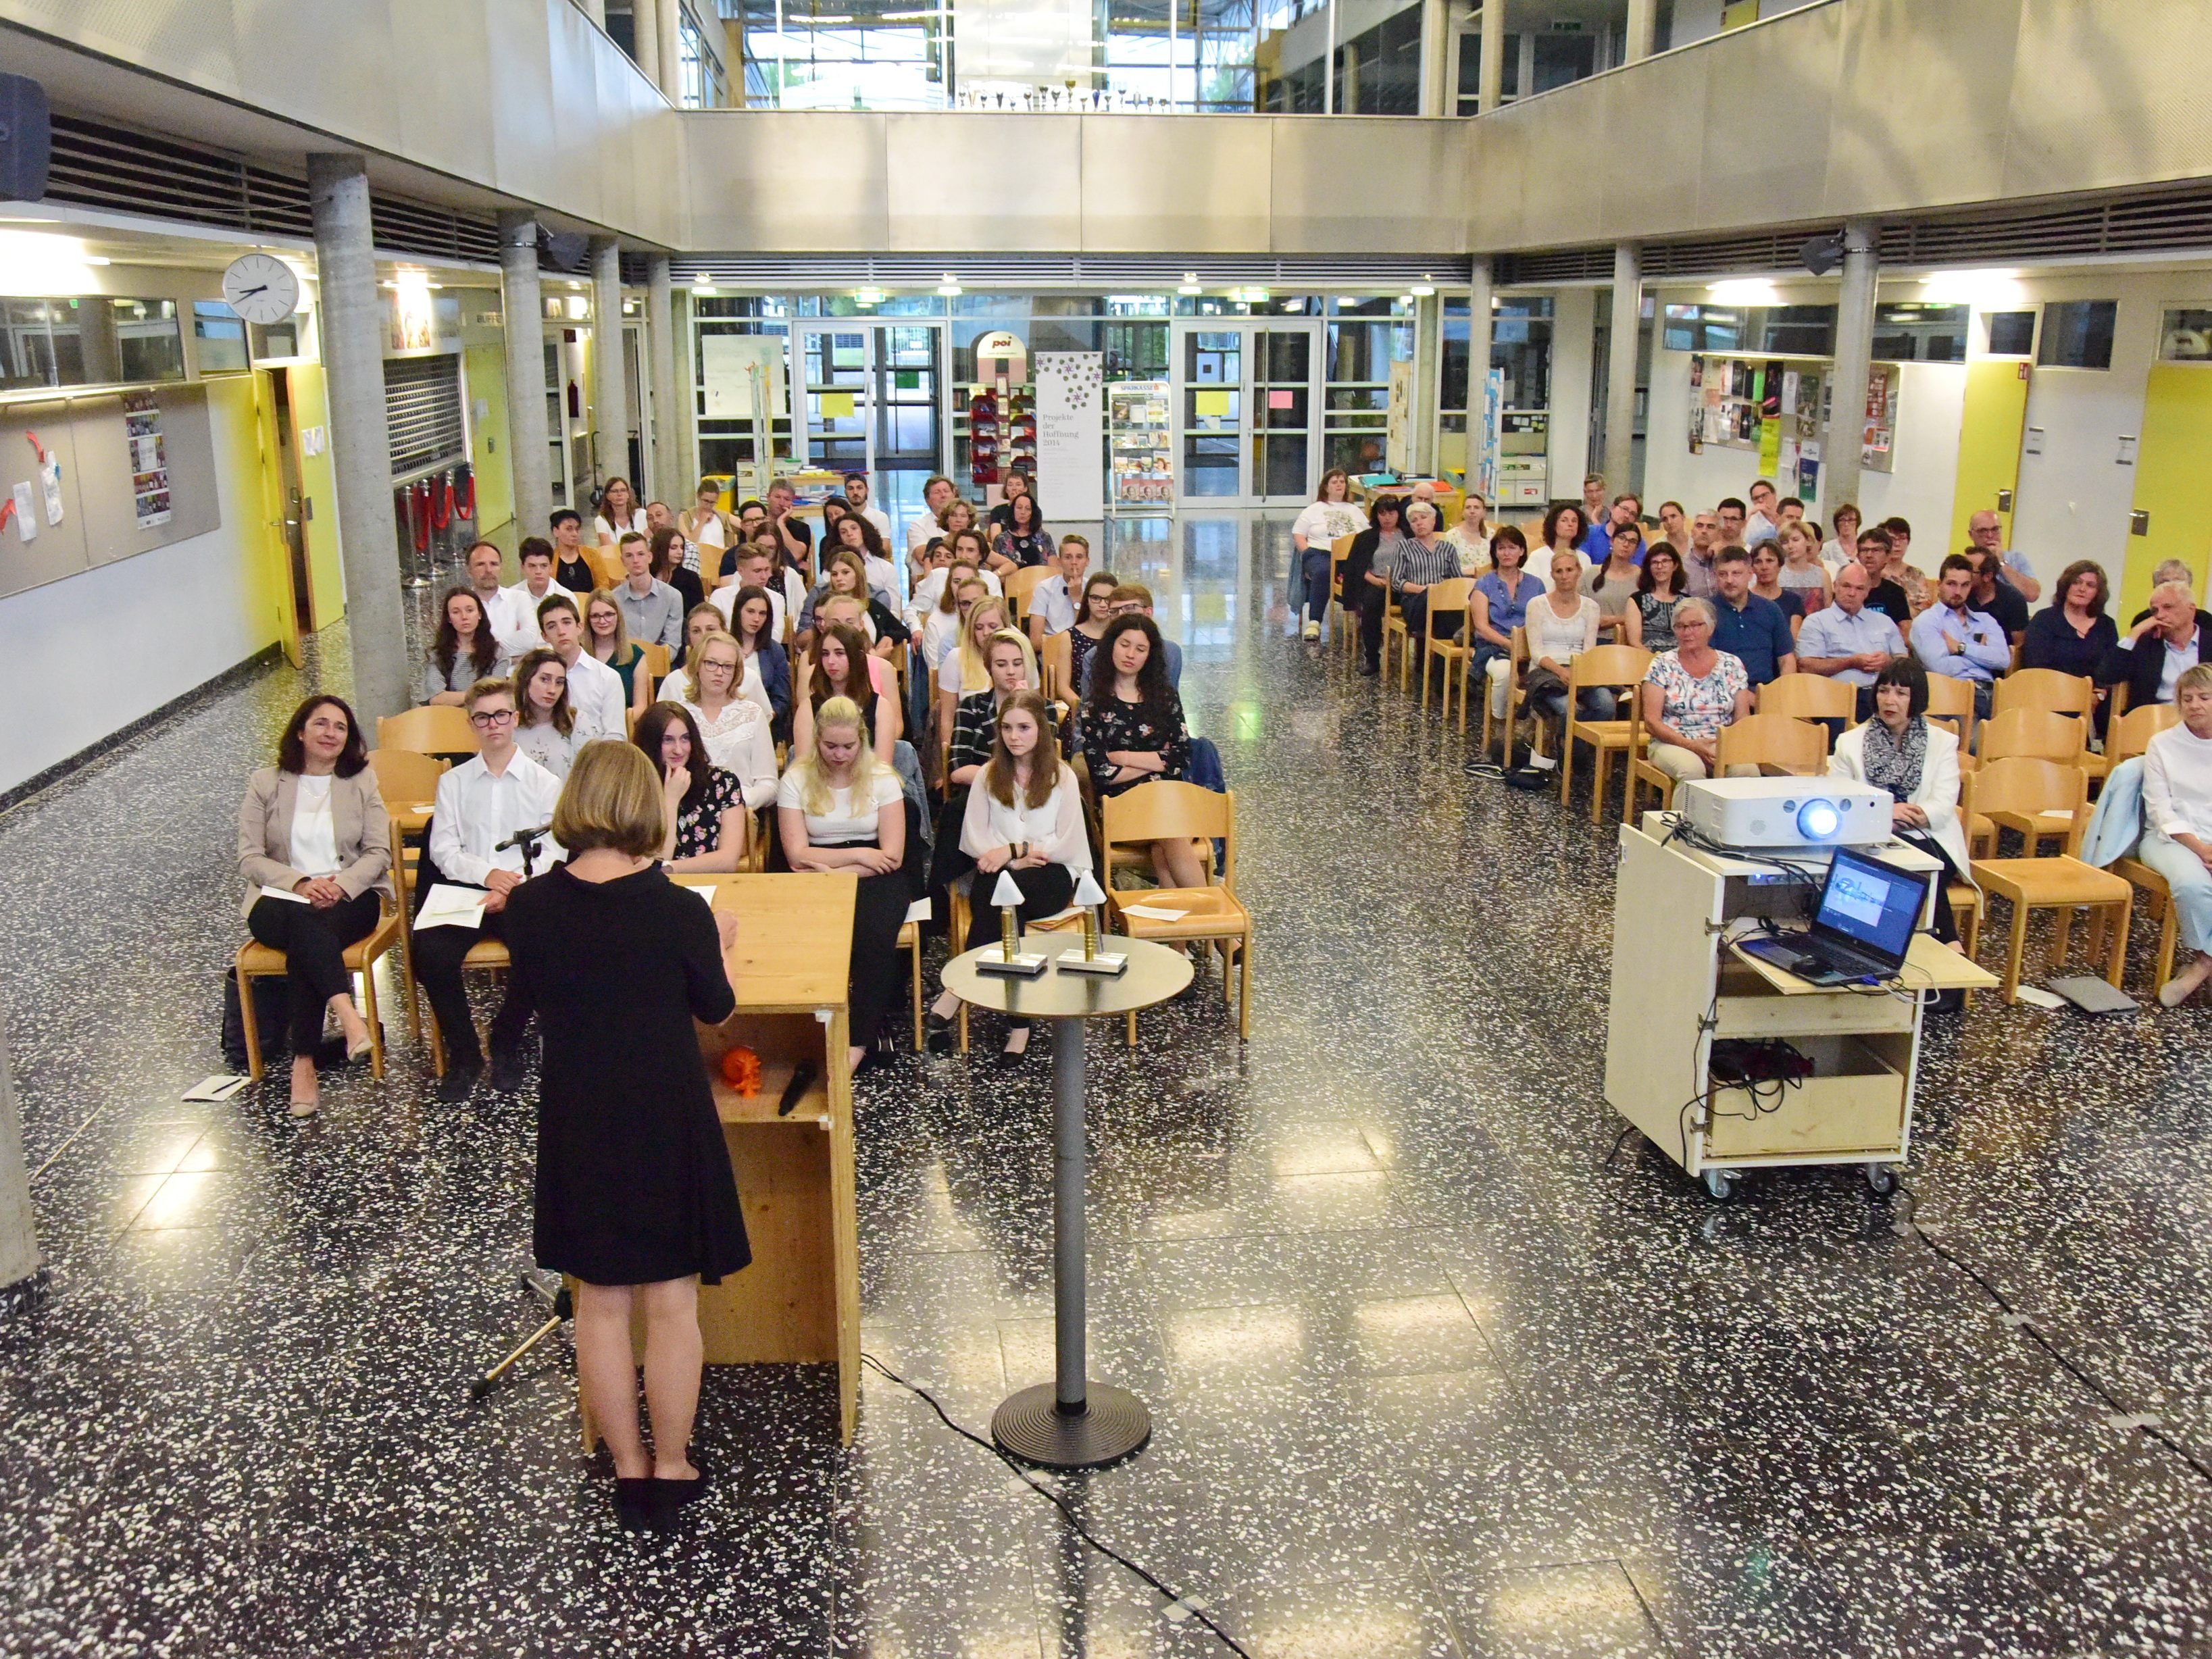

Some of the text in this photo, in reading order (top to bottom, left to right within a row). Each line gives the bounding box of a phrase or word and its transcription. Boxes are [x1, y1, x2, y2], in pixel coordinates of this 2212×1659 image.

[476, 315, 503, 324] BUFFE
[992, 336, 1012, 349] poi
[1042, 413, 1074, 422] Projekte
[1042, 430, 1079, 439] Hoffnung
